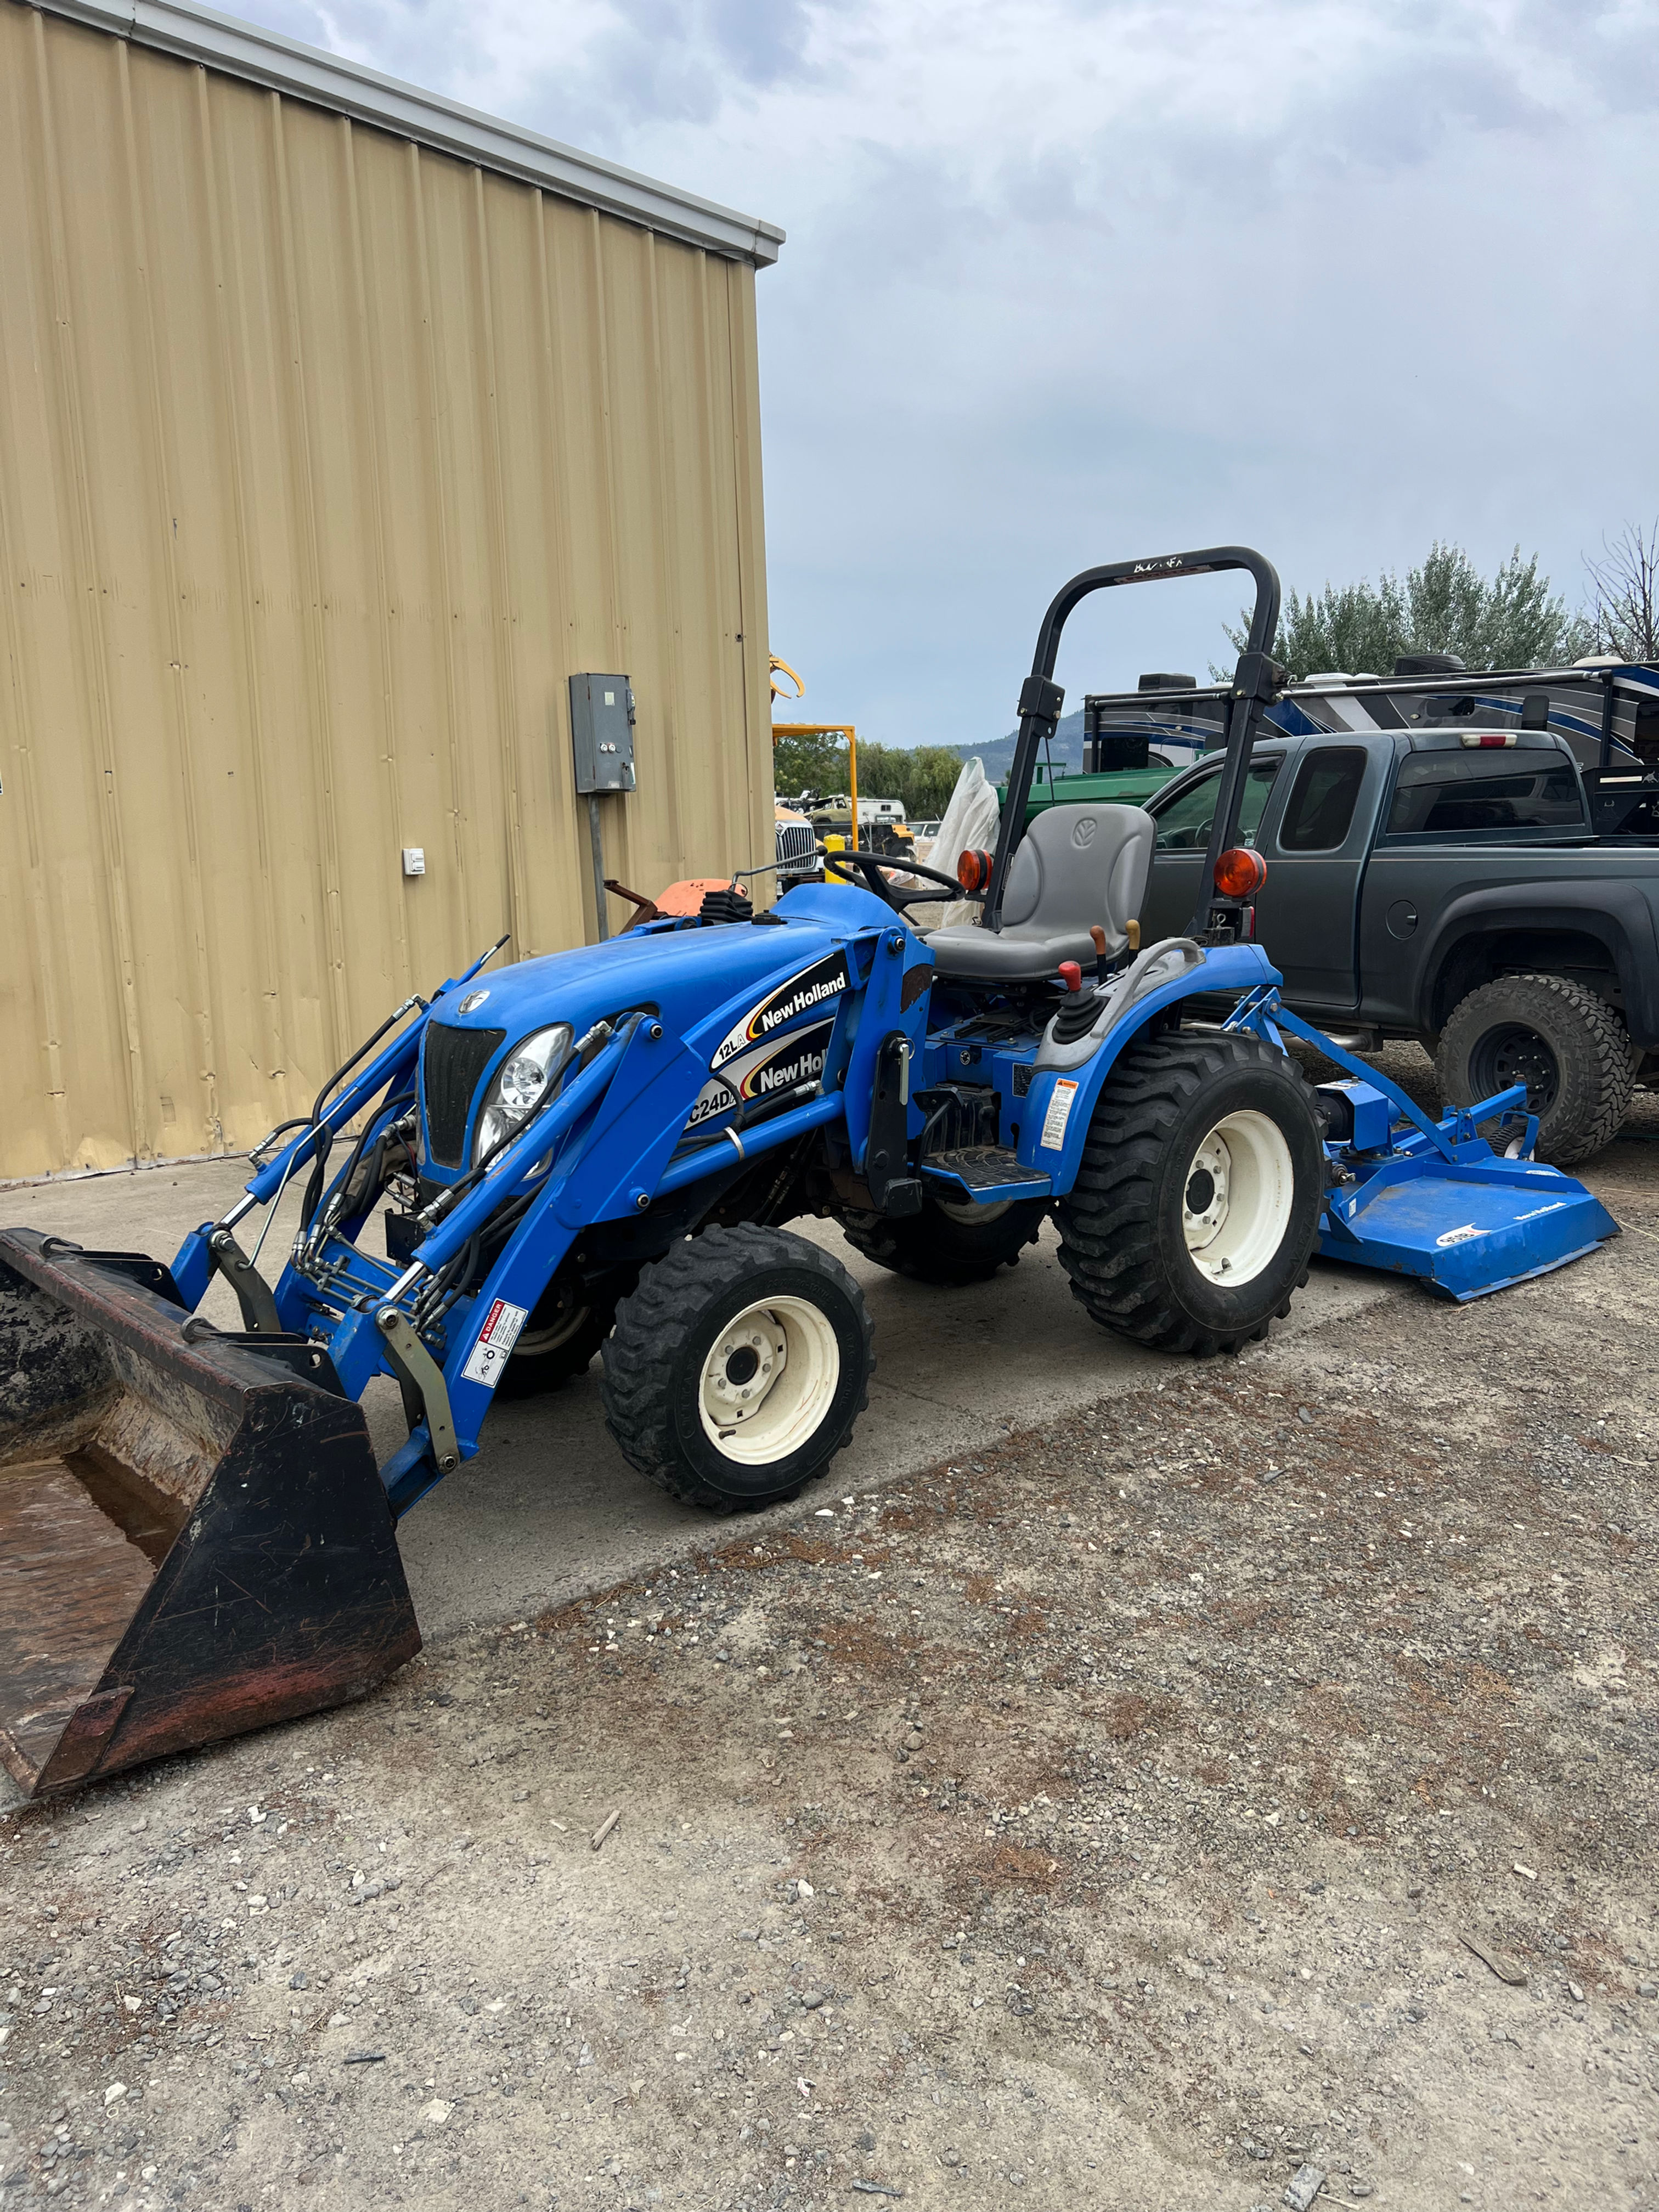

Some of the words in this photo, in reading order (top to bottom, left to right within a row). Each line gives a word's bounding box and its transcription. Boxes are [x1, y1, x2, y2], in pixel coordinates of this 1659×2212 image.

[761, 1001, 794, 1032] New
[793, 972, 845, 1013] Holland
[719, 1034, 746, 1060] 12LA
[760, 1062, 799, 1092] New
[486, 1304, 502, 1332] DANGER
